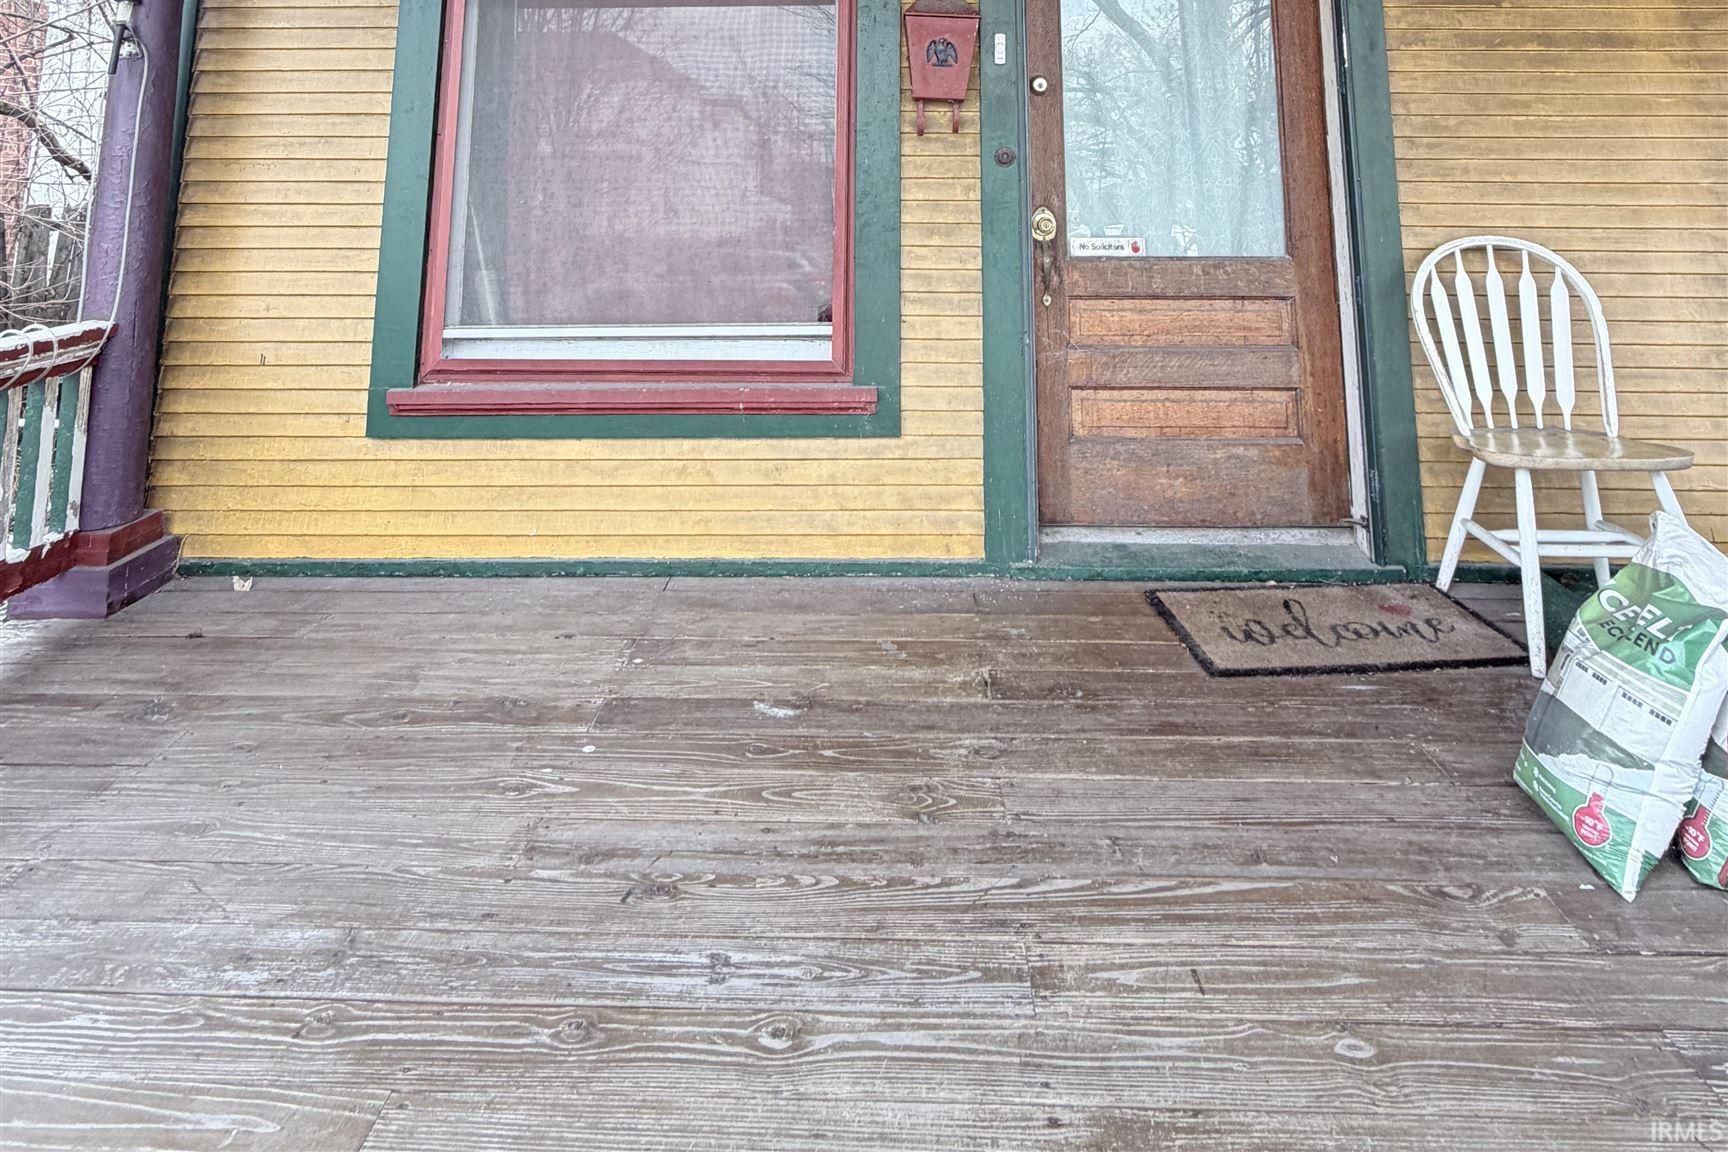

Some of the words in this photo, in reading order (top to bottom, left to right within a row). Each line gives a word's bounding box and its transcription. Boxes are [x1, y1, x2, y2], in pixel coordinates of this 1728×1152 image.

[1078, 242, 1089, 251] No
[1090, 242, 1125, 251] Solicitors
[1597, 579, 1642, 622] CE
[1220, 598, 1456, 649] welcome
